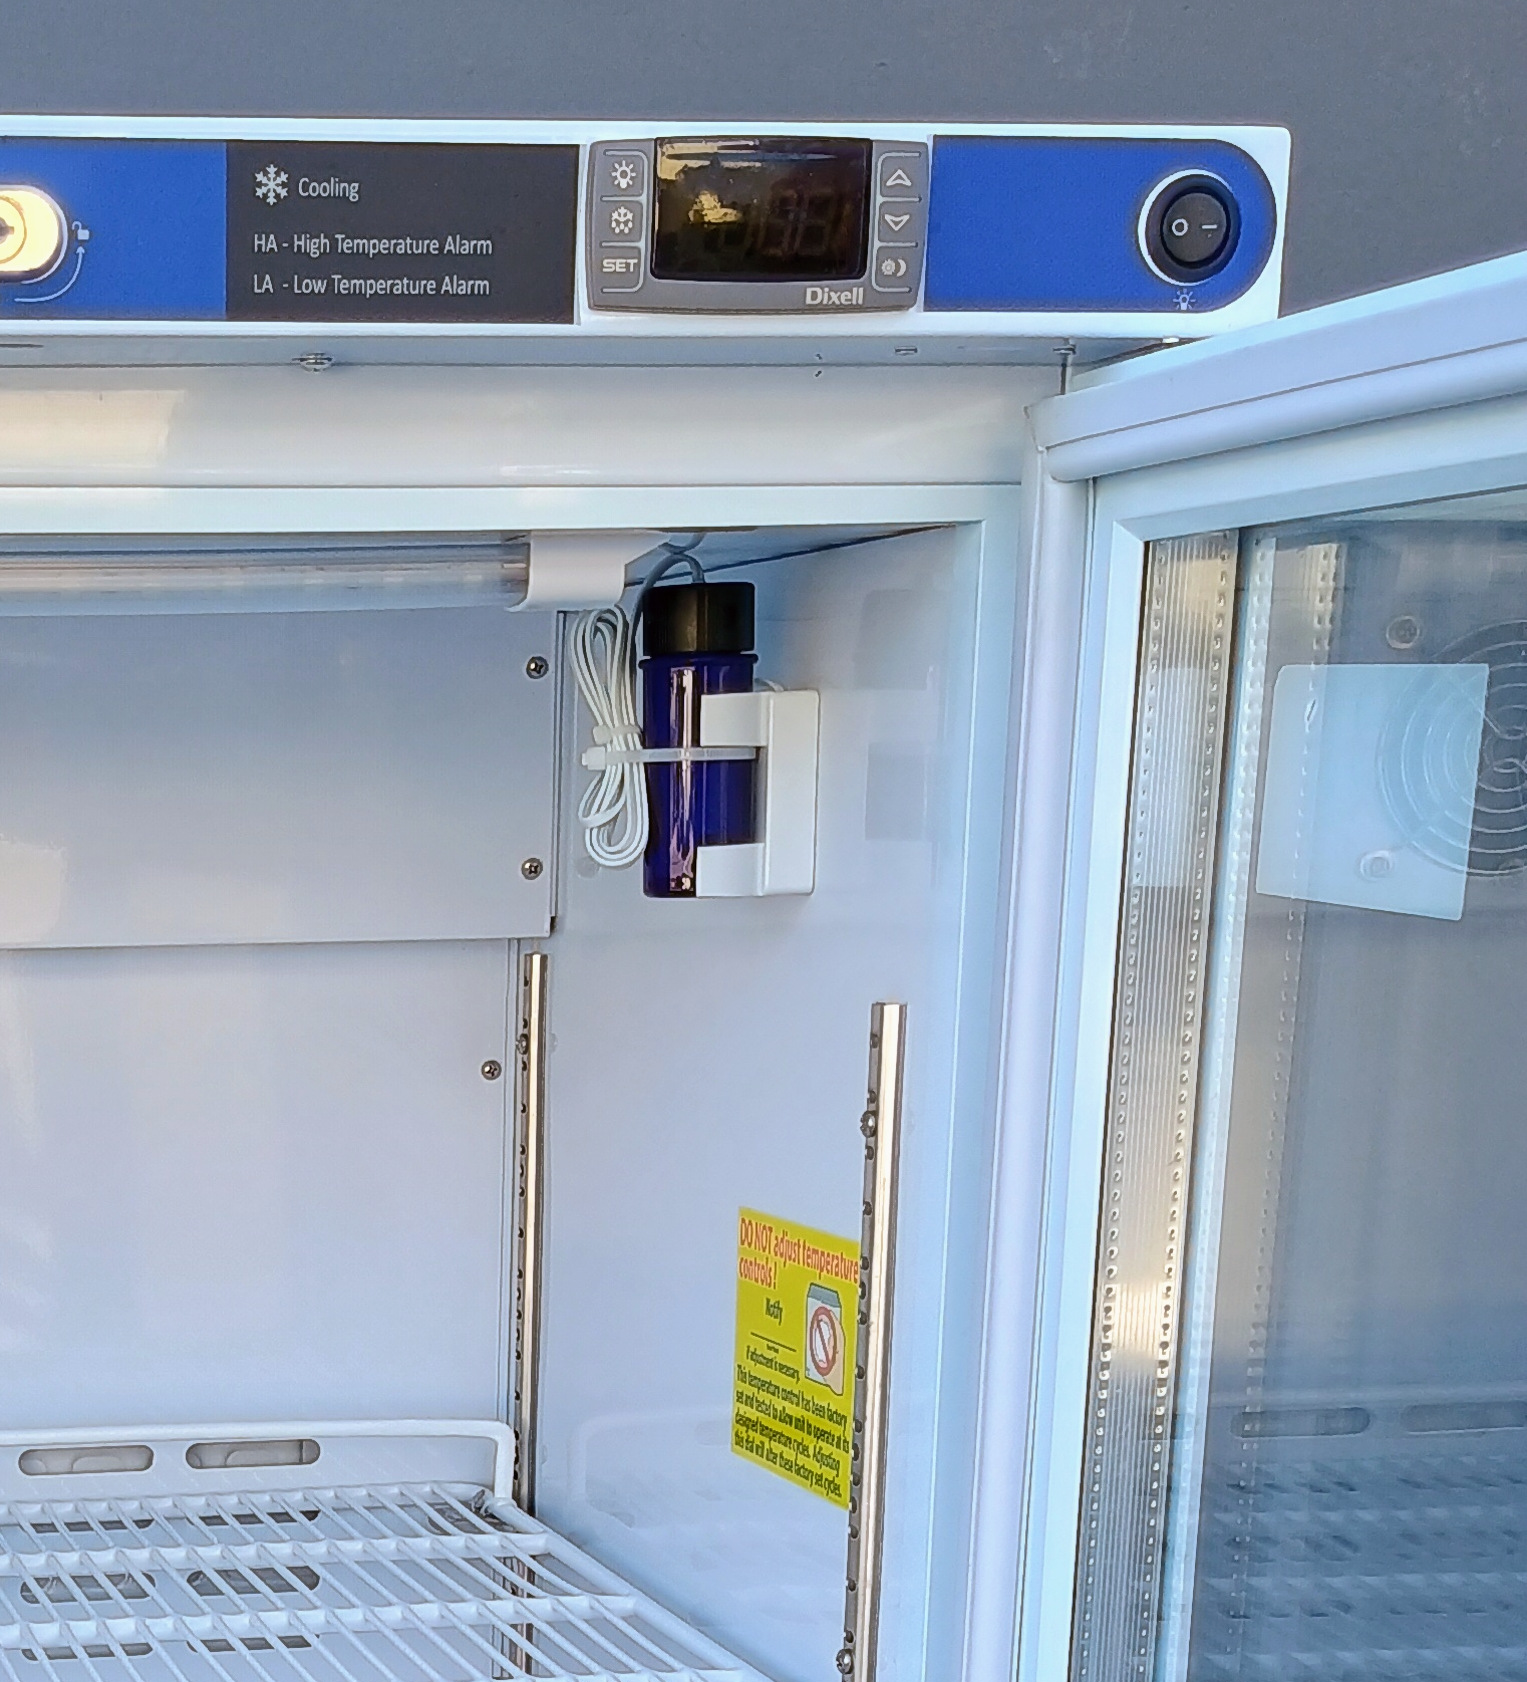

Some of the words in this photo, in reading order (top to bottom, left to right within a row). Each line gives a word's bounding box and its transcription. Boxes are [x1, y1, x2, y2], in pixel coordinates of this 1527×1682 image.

[297, 177, 359, 202] Cooling
[253, 234, 278, 254] HA
[293, 234, 330, 258] High
[334, 234, 439, 257] Temperature
[443, 235, 493, 256] Alarm
[602, 258, 638, 273] SET
[253, 275, 273, 294] LA
[293, 275, 327, 295] Low
[332, 275, 437, 298] Temperature
[441, 276, 490, 296] Alarm
[805, 287, 864, 306] Dixell
[740, 1217, 753, 1249] DO
[754, 1222, 773, 1254] NOT
[773, 1229, 801, 1268] adjust
[802, 1240, 859, 1284] temperature
[739, 1257, 772, 1288] controls
